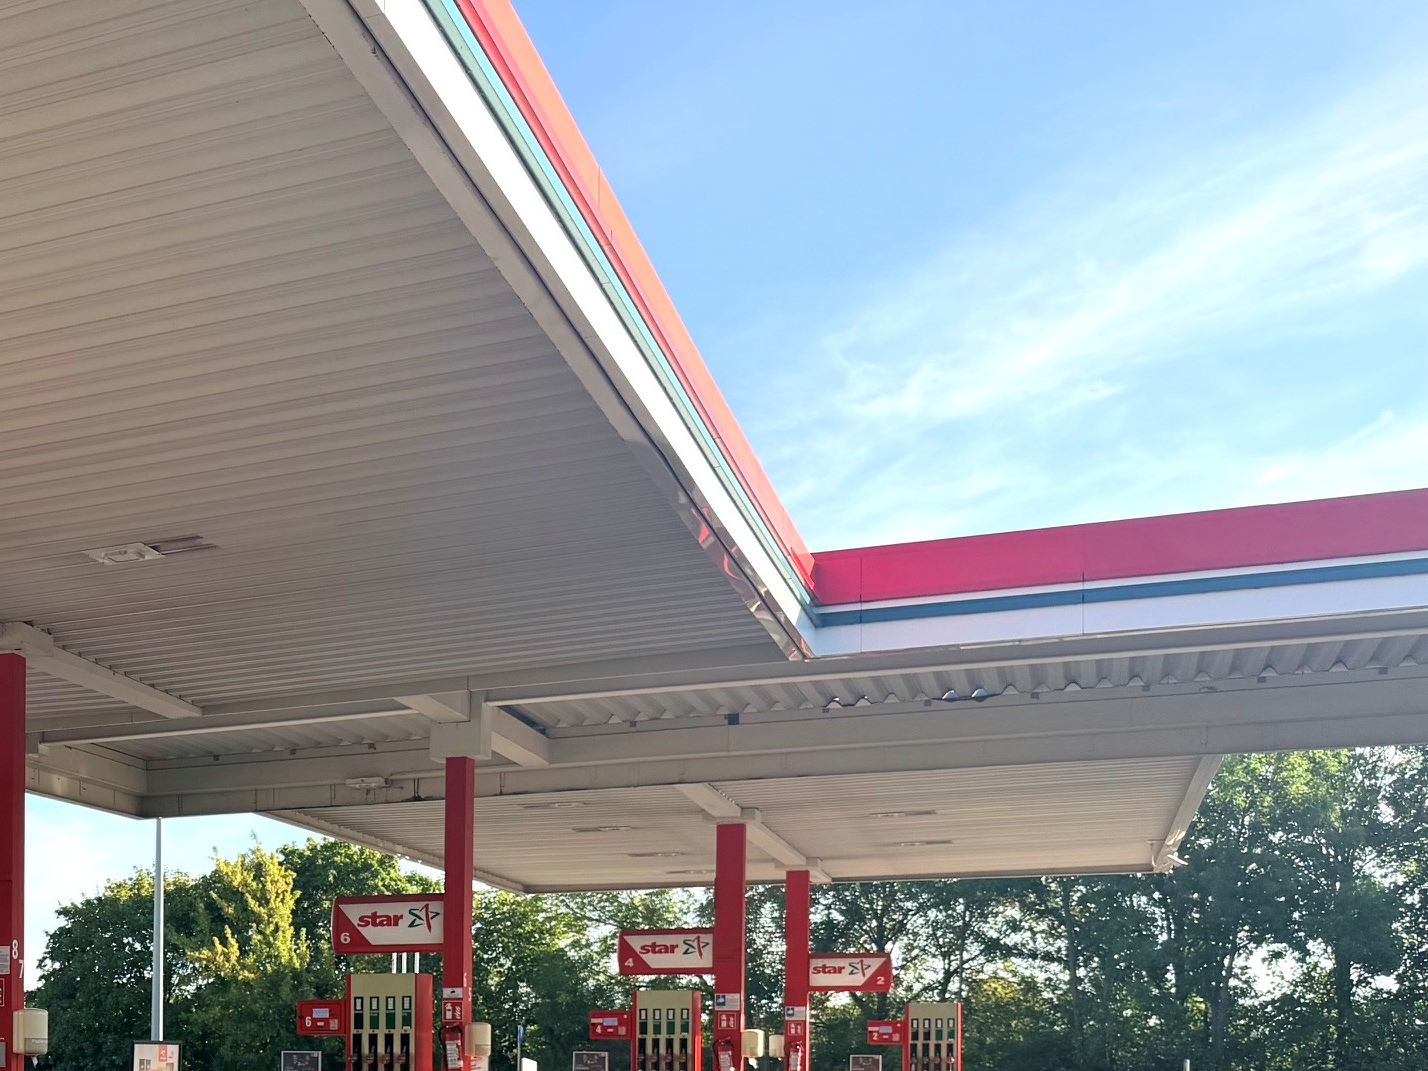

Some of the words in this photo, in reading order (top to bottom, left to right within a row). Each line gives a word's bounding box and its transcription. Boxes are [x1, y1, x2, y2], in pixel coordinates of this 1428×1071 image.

[357, 911, 403, 928] star
[340, 932, 351, 944] 6
[12, 939, 19, 960] 8
[639, 941, 679, 955] star
[624, 957, 634, 967] 4
[18, 959, 24, 979] 7
[811, 963, 845, 975] star
[876, 976, 885, 984] 2
[305, 1016, 312, 1027] 6
[595, 1025, 602, 1034] 4
